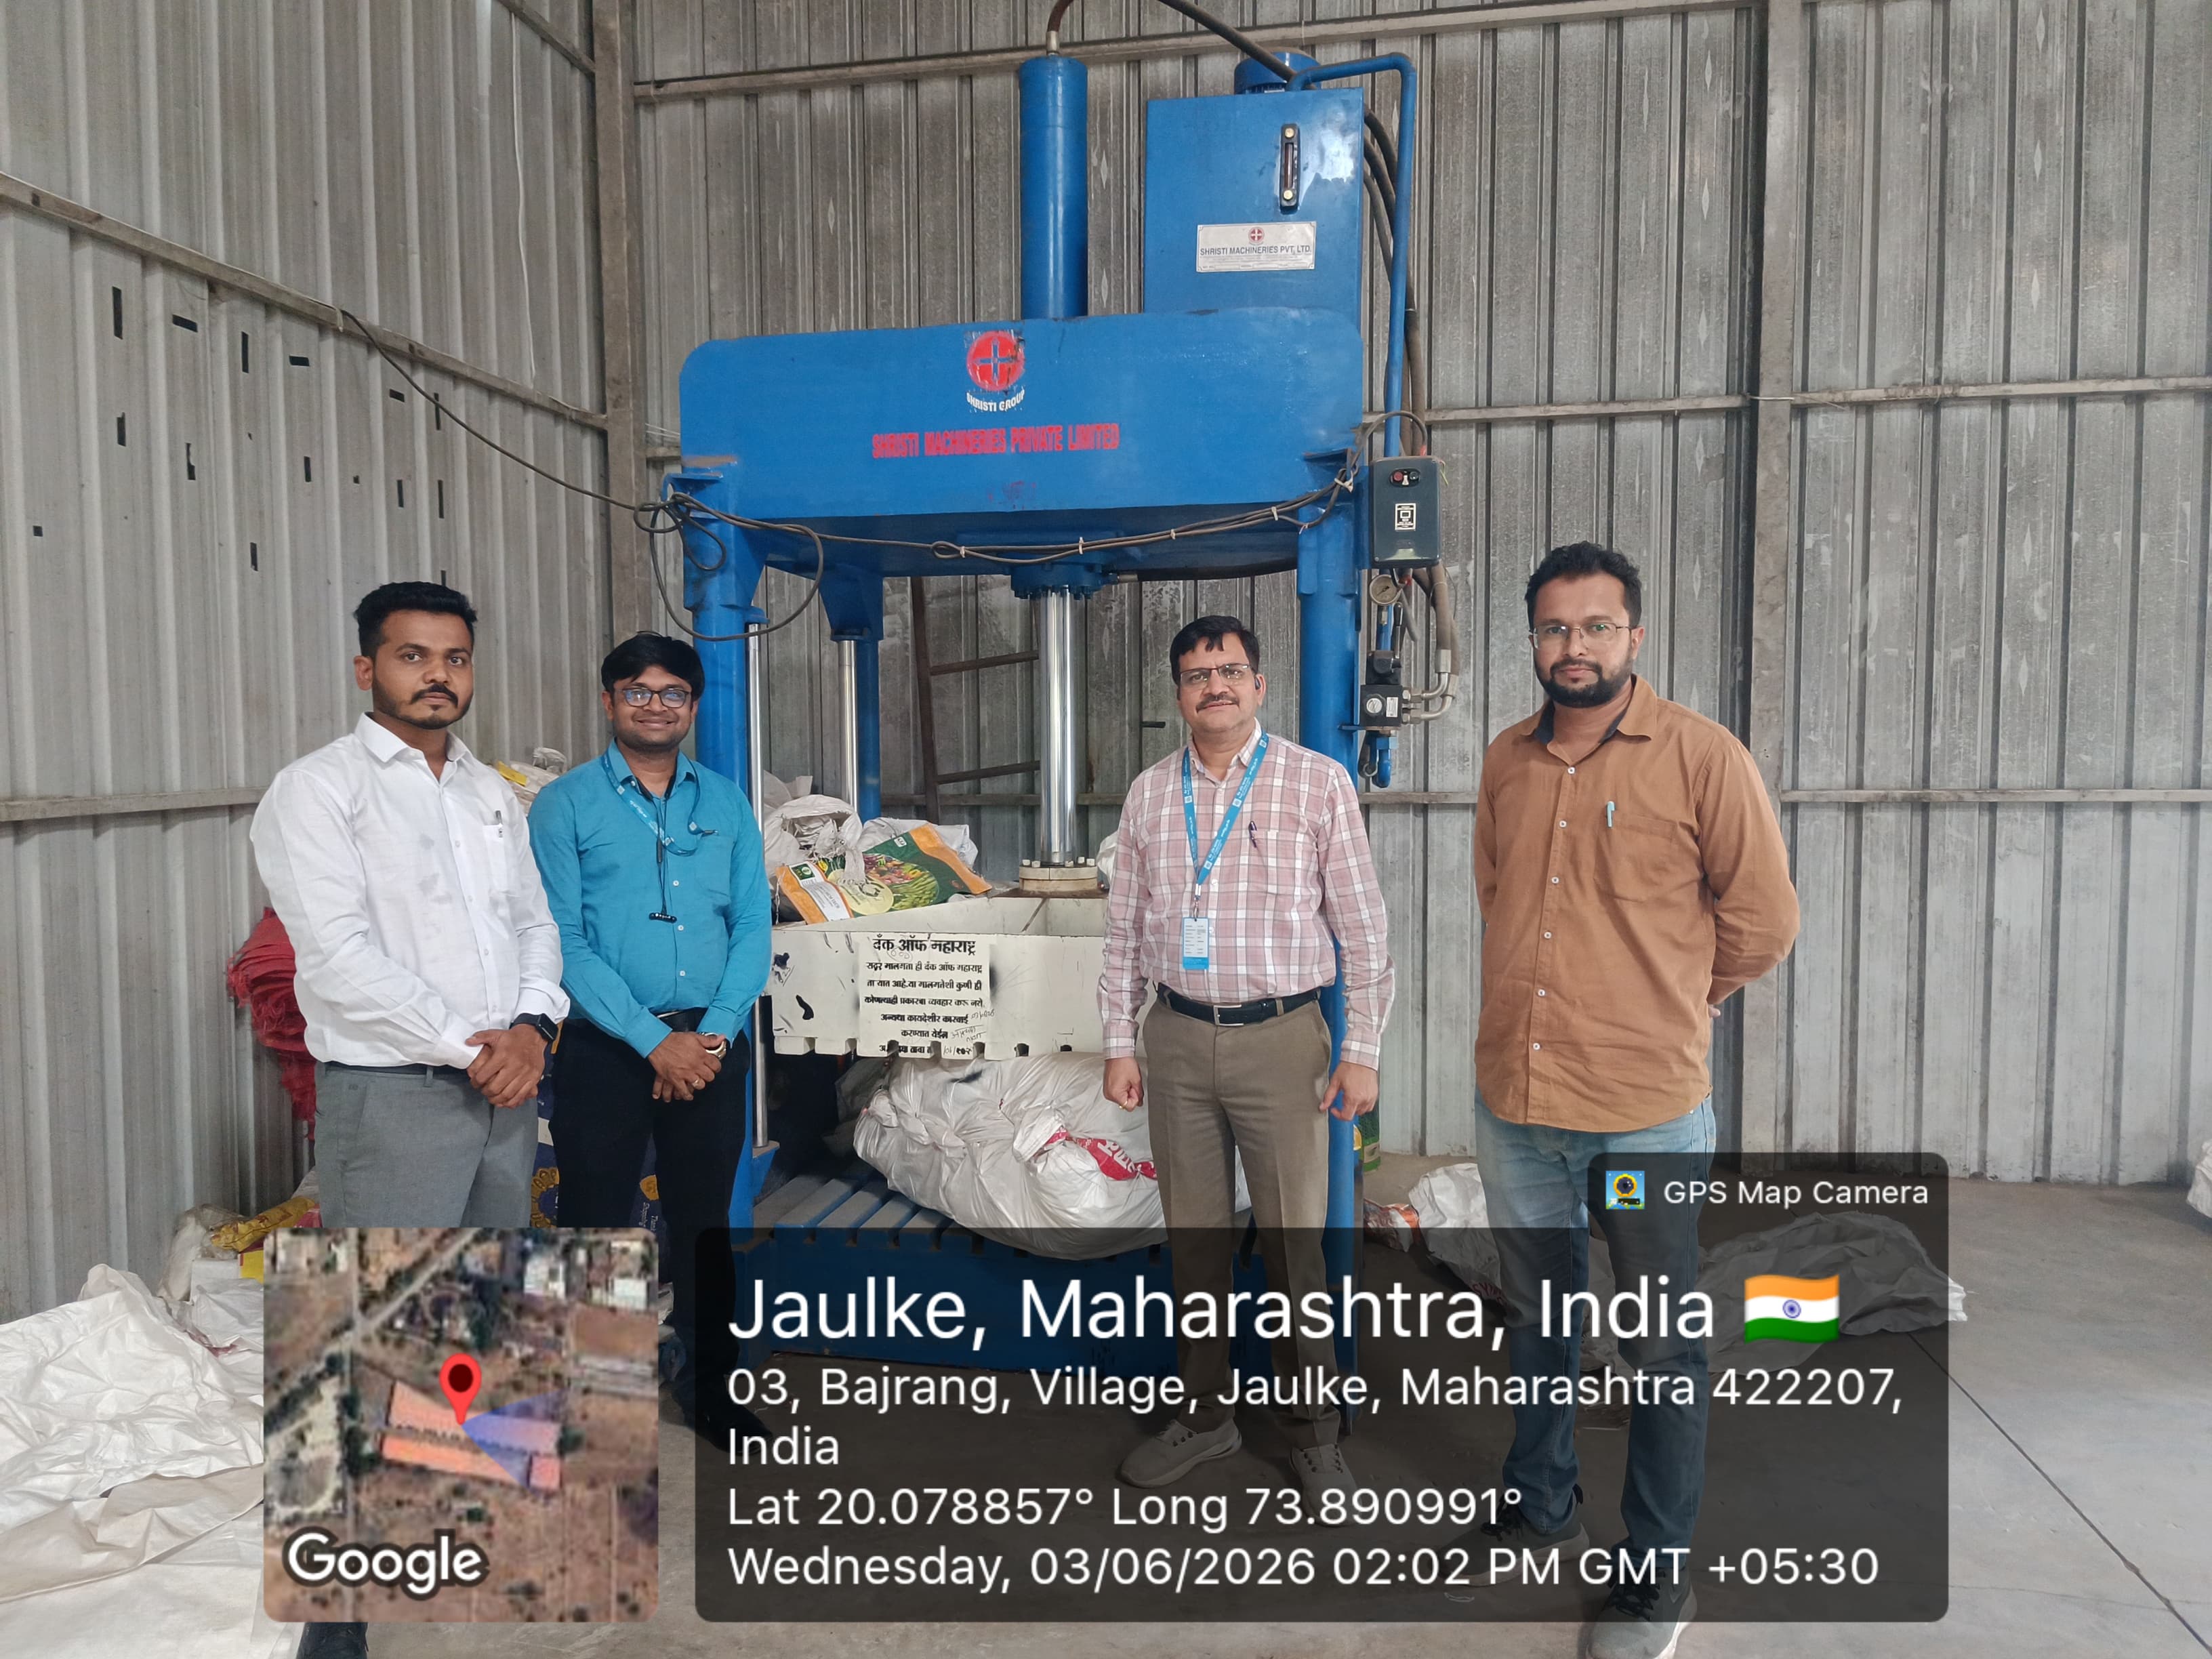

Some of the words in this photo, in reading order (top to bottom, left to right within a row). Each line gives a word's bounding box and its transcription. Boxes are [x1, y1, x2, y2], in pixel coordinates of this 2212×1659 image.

[1200, 247, 1228, 256] SHRISTI
[1229, 245, 1279, 255] MACHINERIES
[966, 392, 997, 412] SHRISTI
[999, 389, 1025, 411] GROUP
[872, 432, 920, 459] SHRISTI
[924, 428, 1006, 457] MACHINERIES
[1010, 424, 1063, 454] PRIVATE
[1068, 422, 1120, 451] LIMITED
